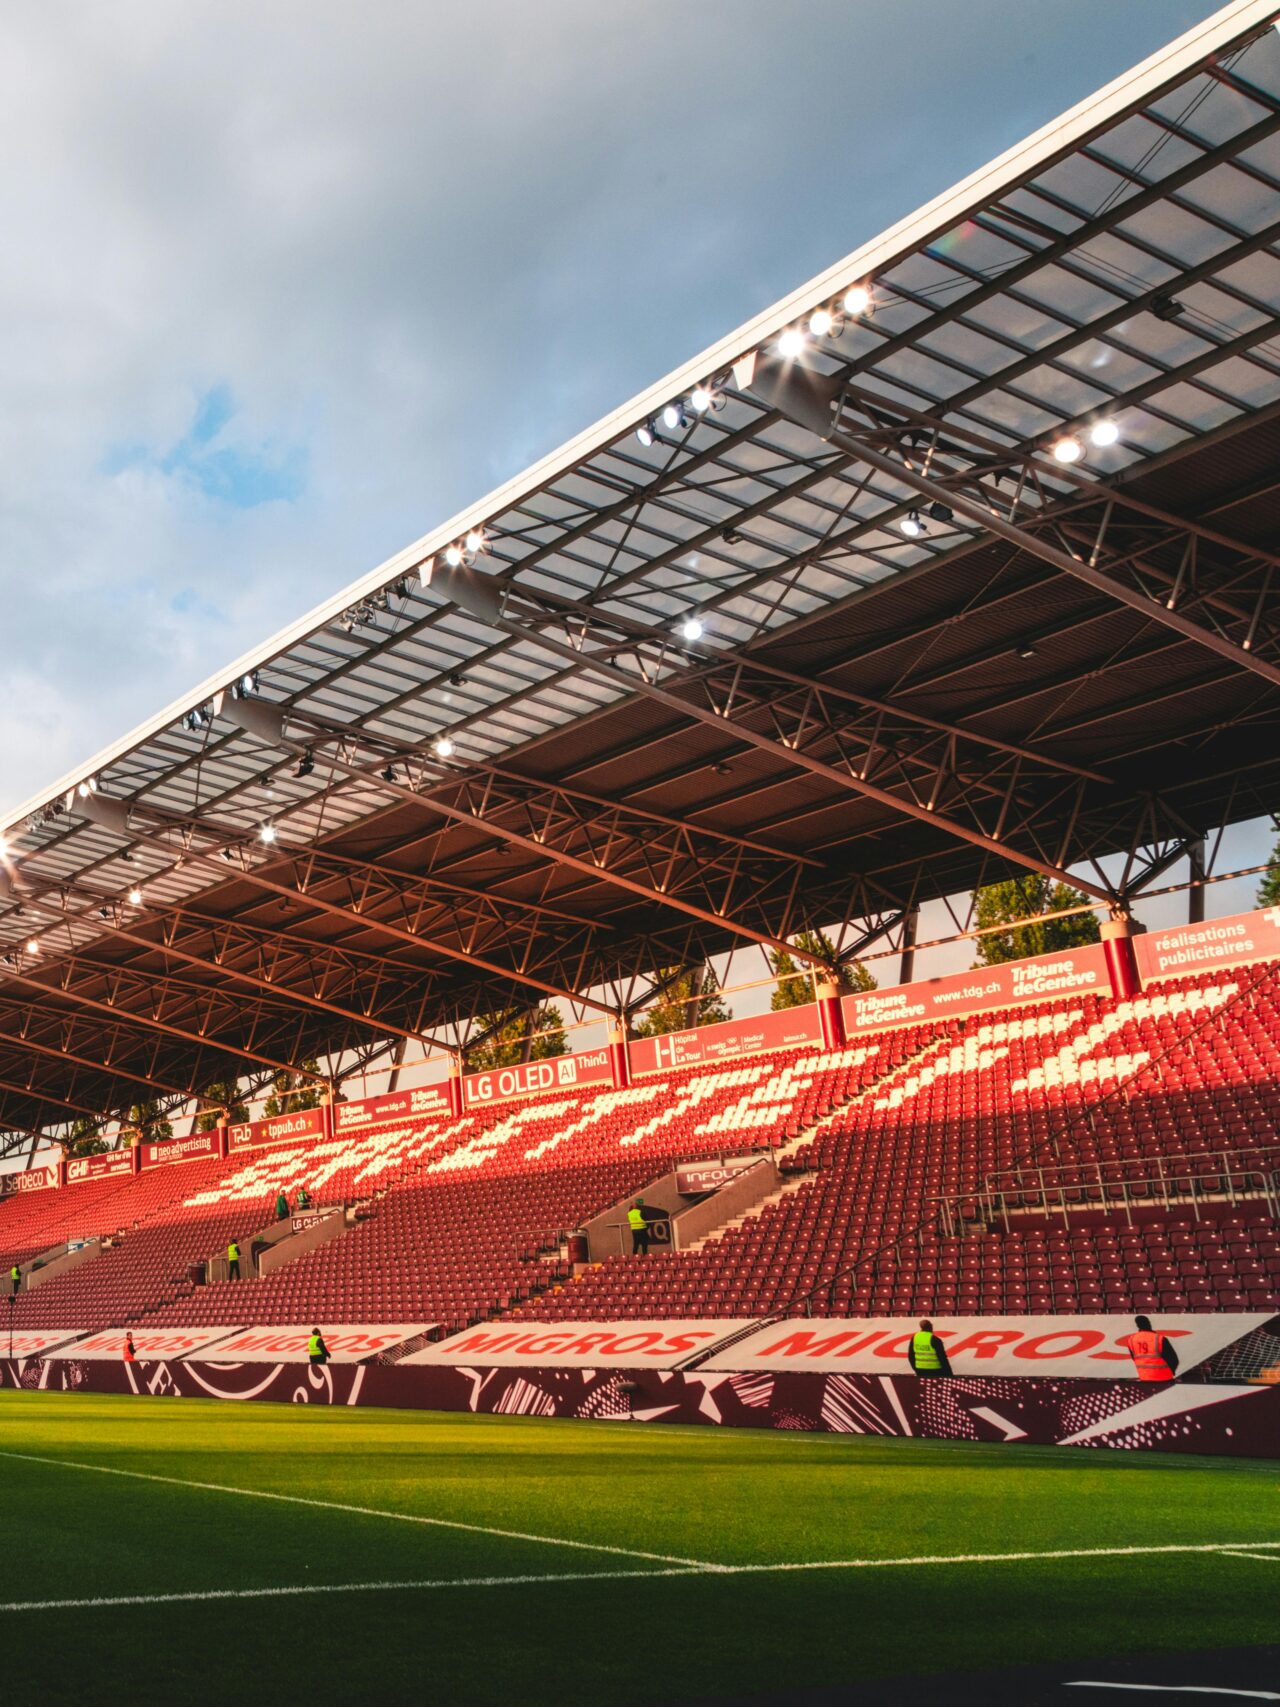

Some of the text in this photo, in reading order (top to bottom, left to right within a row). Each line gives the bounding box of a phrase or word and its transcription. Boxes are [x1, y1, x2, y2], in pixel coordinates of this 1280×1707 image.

[1155, 925, 1246, 951] réalisations
[1159, 940, 1255, 971] publicitaires
[1011, 960, 1074, 982] Tribune
[933, 982, 1001, 1004] www.tdg.ch
[1012, 970, 1096, 996] deGenève
[855, 993, 907, 1013] Tribune
[856, 1003, 925, 1026] deGenève
[674, 1033, 697, 1046] Hôpital
[676, 1046, 684, 1054] de
[686, 1052, 701, 1062] Tour
[467, 1076, 492, 1102] LG
[499, 1064, 553, 1095] OLED
[577, 1051, 608, 1069] ThinQ
[410, 1089, 438, 1102] Tribune
[268, 1118, 306, 1139] tppub.ch
[158, 1137, 211, 1157] neo advertising
[6, 1172, 44, 1192] Serbeco
[293, 1219, 302, 1230] LG
[440, 1332, 716, 1356] MIGROS
